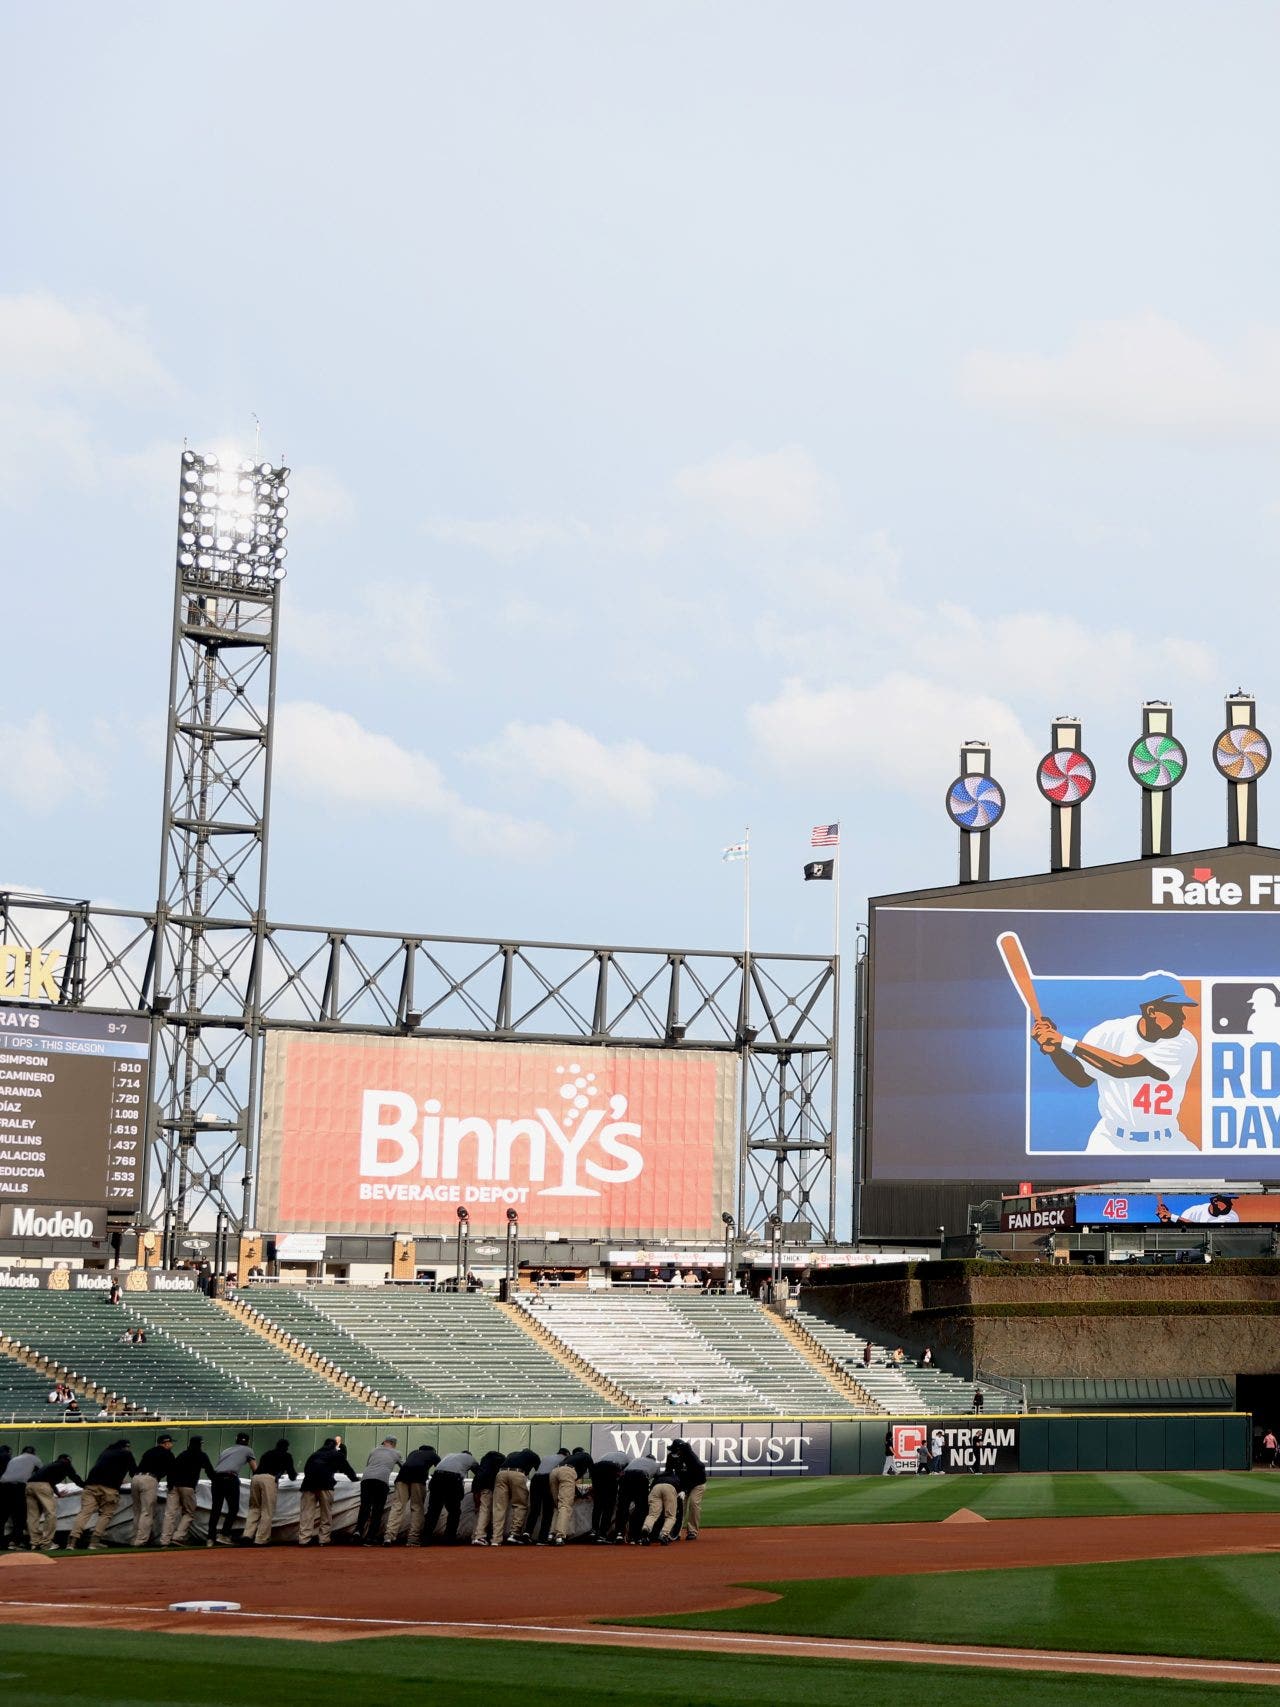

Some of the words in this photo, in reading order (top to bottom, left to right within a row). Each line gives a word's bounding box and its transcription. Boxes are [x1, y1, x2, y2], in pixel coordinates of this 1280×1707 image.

[1152, 867, 1242, 905] Rate
[0, 1012, 40, 1028] RAYS
[108, 1023, 127, 1034] 9-7
[12, 1037, 33, 1048] OPS
[41, 1039, 64, 1050] THIS
[65, 1042, 105, 1053] SEASON
[0, 1053, 49, 1067] SIMPSON
[118, 1062, 142, 1073] .910
[0, 1070, 56, 1083] CAMINERO
[116, 1078, 140, 1088] .714
[0, 1086, 42, 1097] ARANDA
[116, 1094, 140, 1104] .720
[1133, 1083, 1174, 1115] 42
[115, 1109, 139, 1119] 1.008
[114, 1125, 138, 1135] .619
[113, 1141, 137, 1150] .437
[112, 1156, 136, 1166] .768
[111, 1172, 135, 1181] .533
[110, 1187, 134, 1197] .772
[359, 1183, 460, 1202] BEVERAGE
[465, 1186, 530, 1204] DEPOT
[1103, 1199, 1128, 1219] 42
[12, 1208, 95, 1238] Modelo
[1008, 1213, 1031, 1229] FAN
[1033, 1210, 1065, 1228] DECK
[0, 1272, 40, 1288] Modelo
[155, 1275, 194, 1290] Modelo
[950, 1448, 998, 1467] NOW
